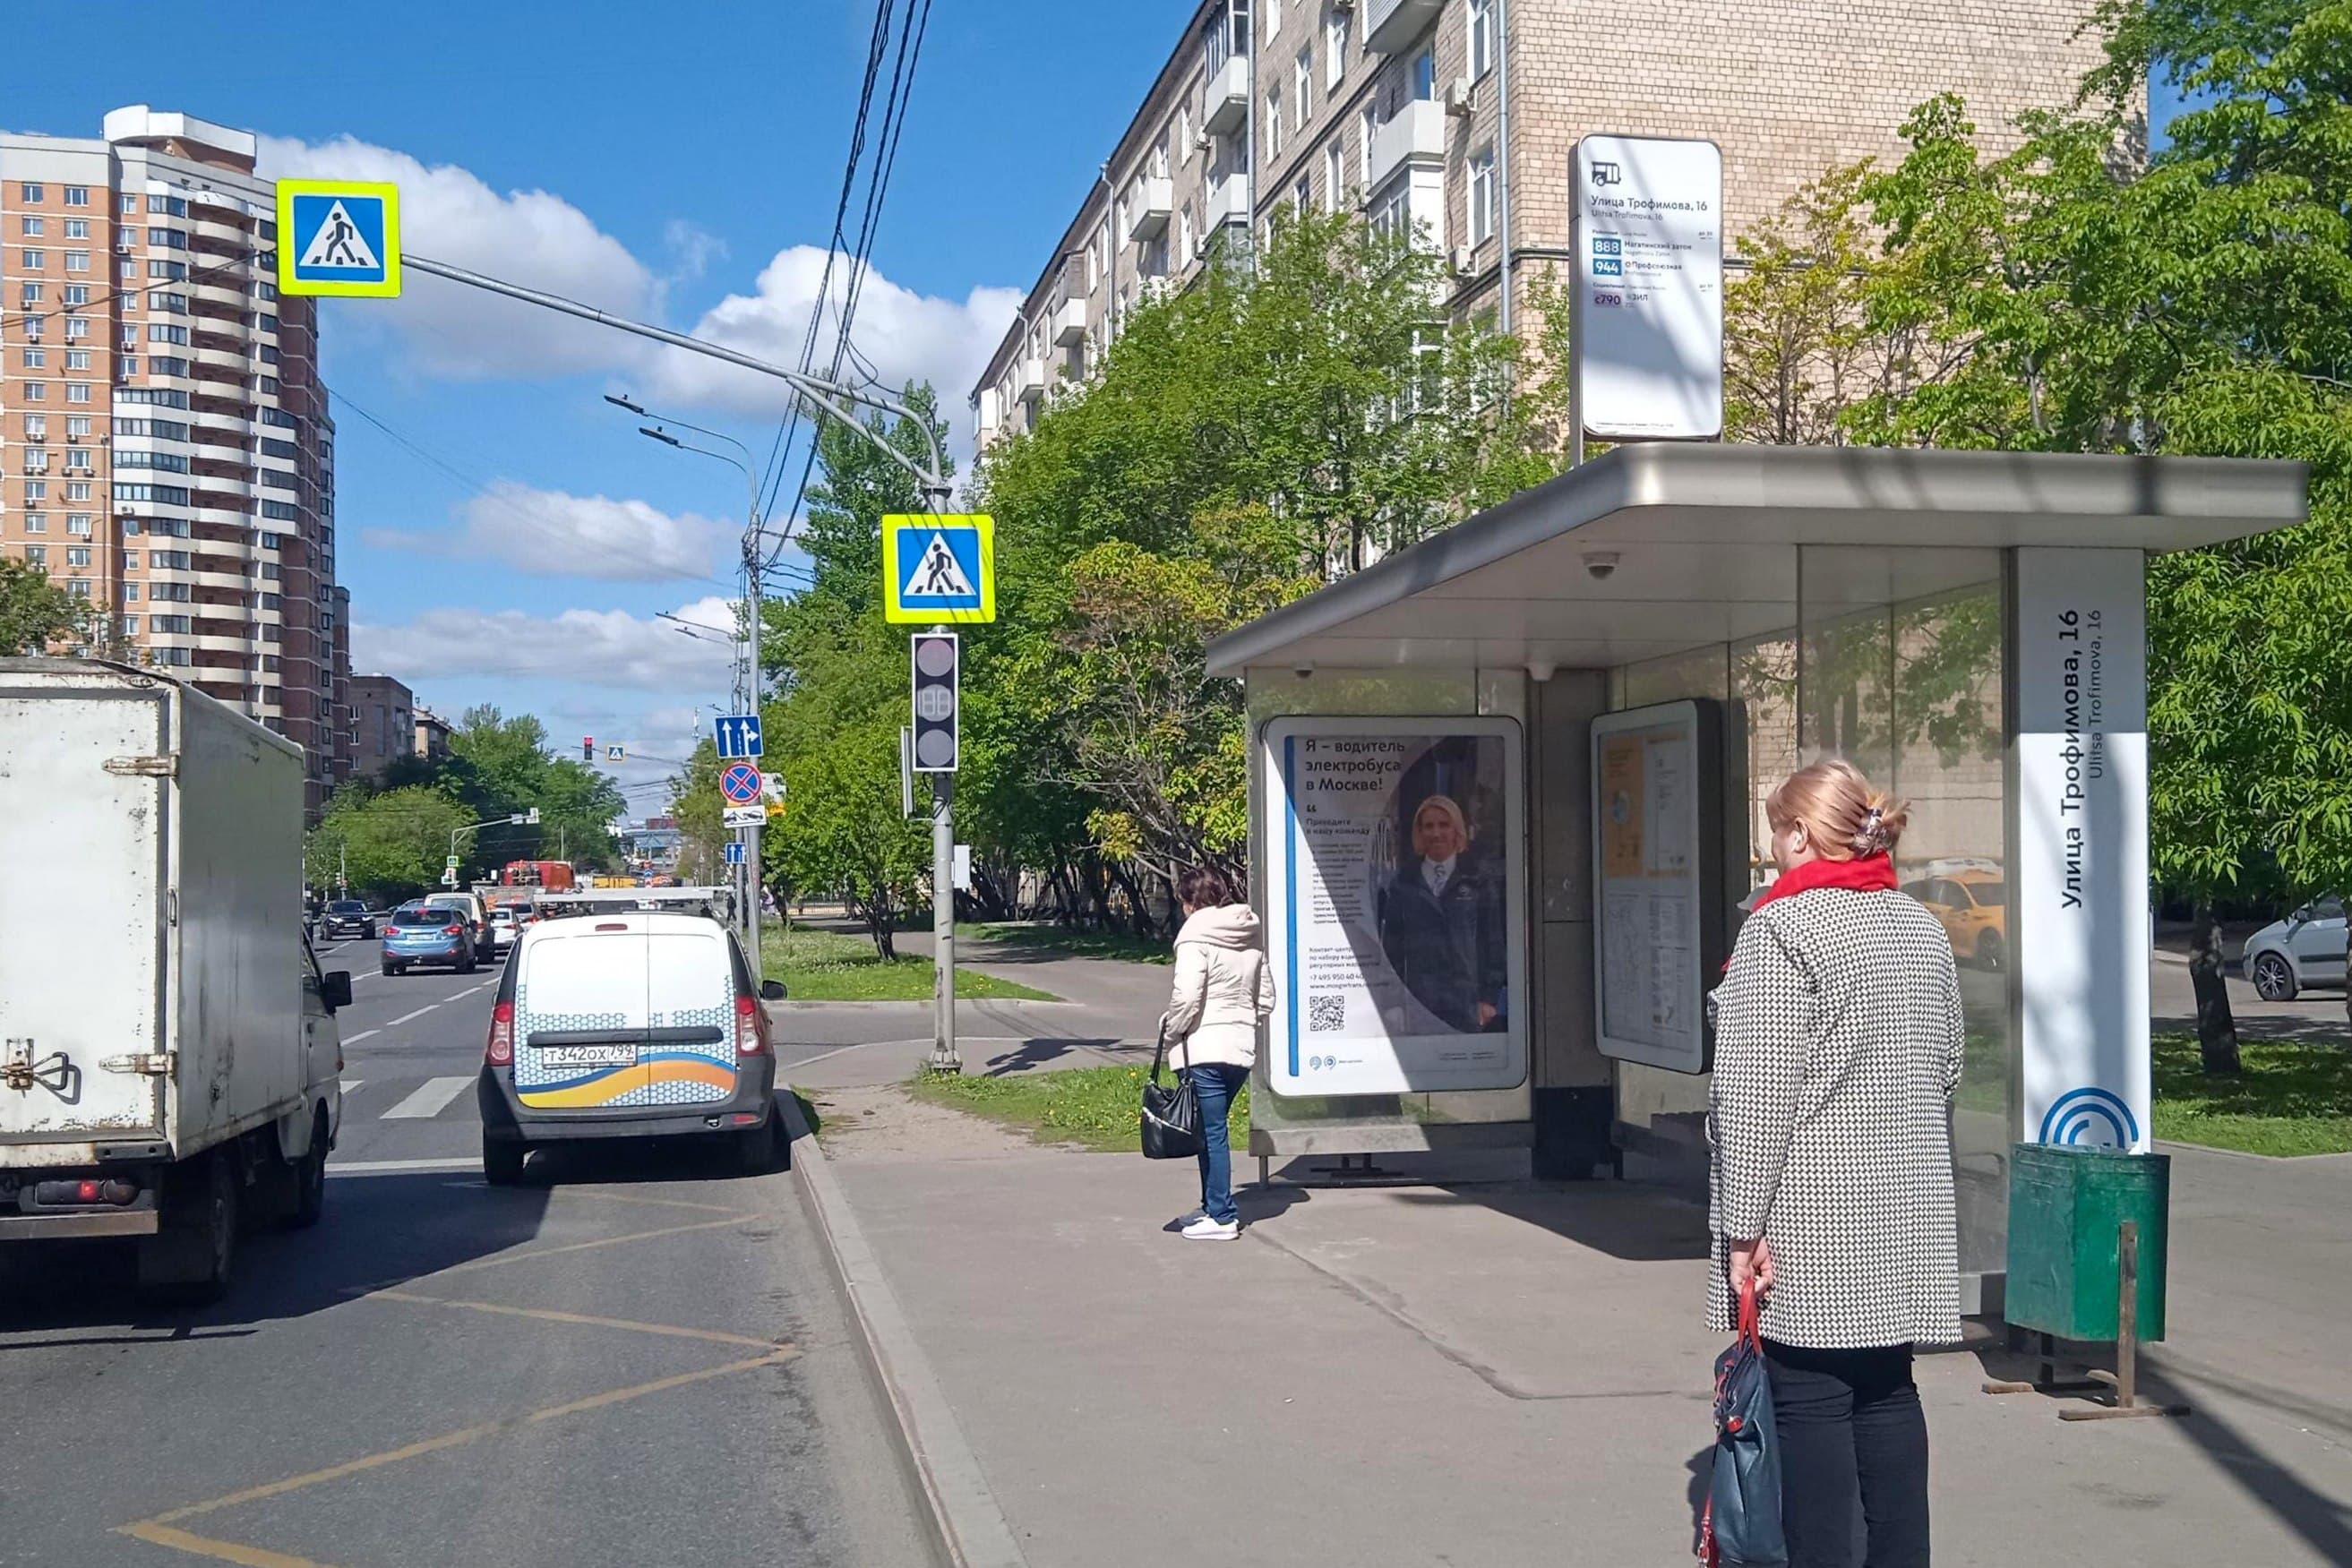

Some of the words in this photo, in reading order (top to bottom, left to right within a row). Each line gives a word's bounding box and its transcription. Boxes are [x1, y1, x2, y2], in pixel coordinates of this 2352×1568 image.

[1591, 194, 1625, 208] Улица
[1627, 197, 1694, 211] Трофимова,
[1696, 201, 1708, 211] 16
[1594, 240, 1619, 253] 888
[1595, 261, 1618, 273] 944
[1594, 294, 1621, 305] с790
[2058, 609, 2079, 640] 16
[2088, 610, 2101, 630] 16
[2088, 635, 2102, 726] Trofimova,
[2059, 650, 2085, 816] Трофимова,
[1306, 740, 1316, 752] Я
[1335, 741, 1404, 753] водитель
[2089, 733, 2102, 779] Ulitsa
[1306, 759, 1401, 774] электробуса
[1306, 781, 1315, 791] в
[1319, 777, 1383, 791] Москве!
[2061, 827, 2083, 909] Улица
